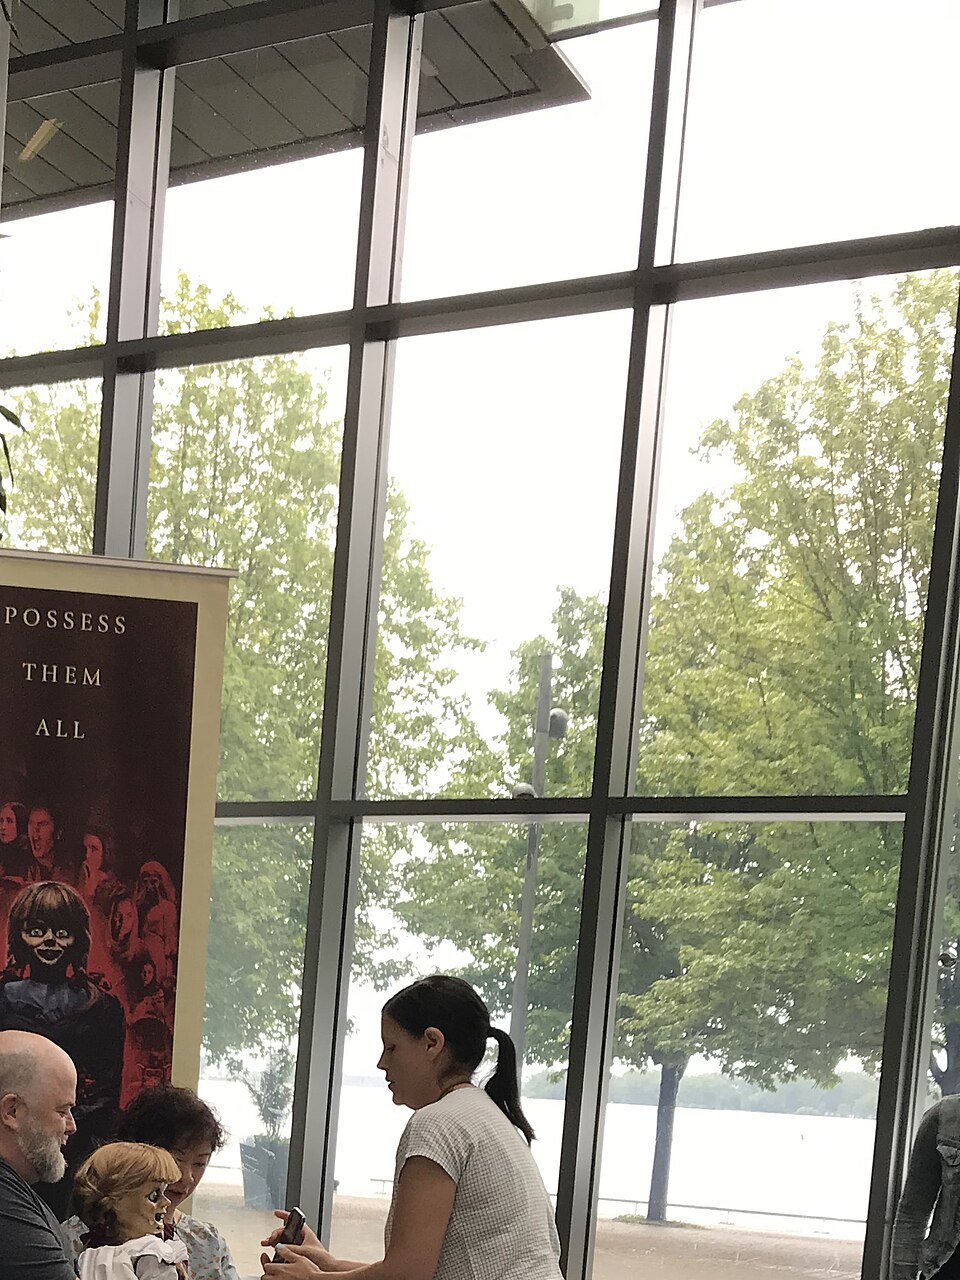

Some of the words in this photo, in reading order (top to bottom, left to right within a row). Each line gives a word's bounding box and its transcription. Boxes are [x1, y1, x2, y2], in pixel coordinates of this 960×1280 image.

[4, 606, 126, 634] POSSESS
[22, 662, 102, 686] THEM
[35, 718, 85, 739] ALL
